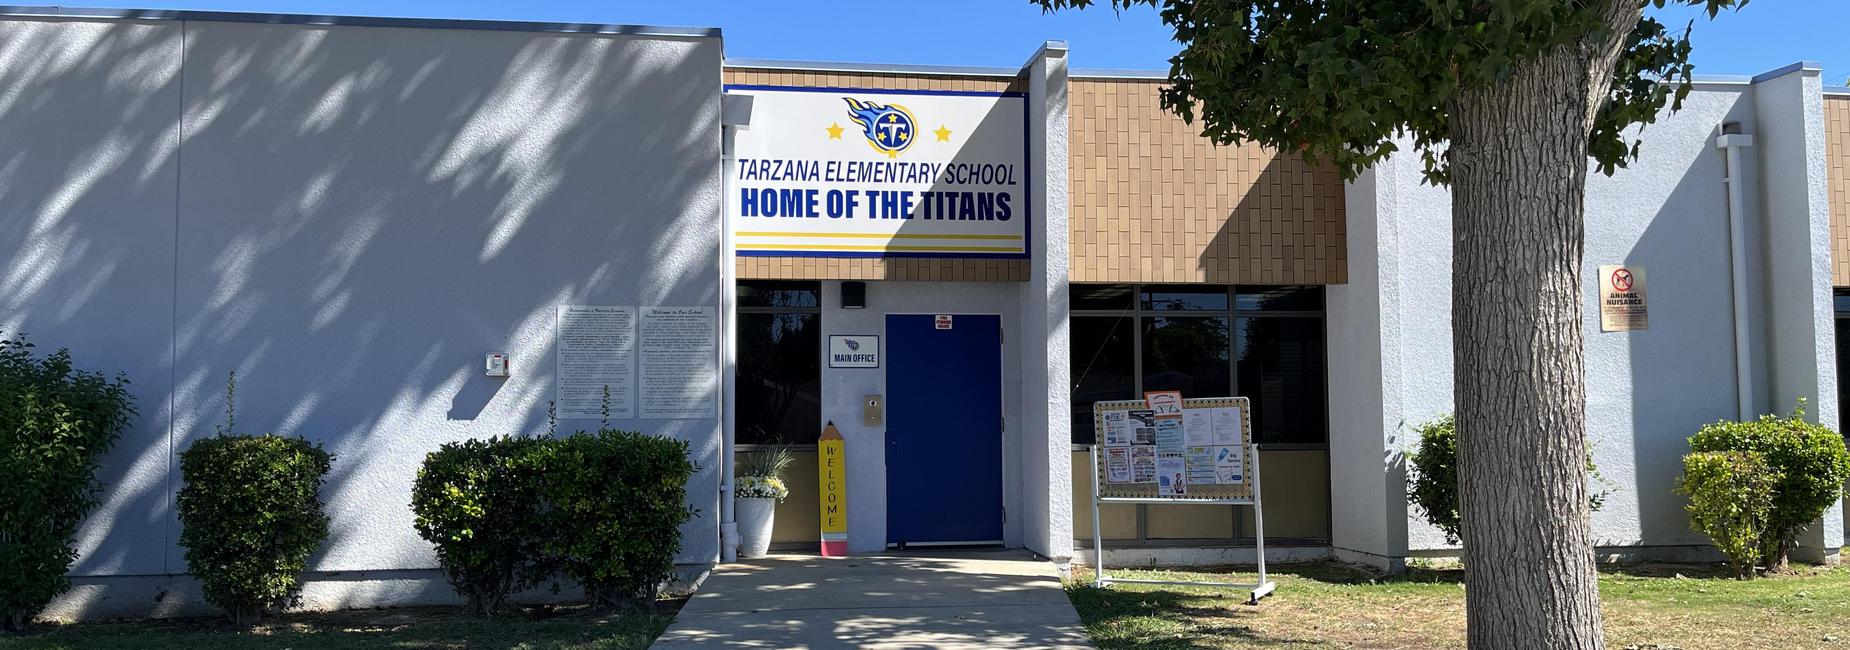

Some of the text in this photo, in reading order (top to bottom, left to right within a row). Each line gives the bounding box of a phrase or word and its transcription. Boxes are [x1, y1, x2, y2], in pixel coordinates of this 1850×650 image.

[738, 158, 1017, 185] TARZANA ELEMENTARY SCHOOL
[741, 187, 1012, 221] HOME OF THE TITANS
[834, 354, 875, 362] MAIN OFFICE
[826, 446, 837, 527] WELCOME
